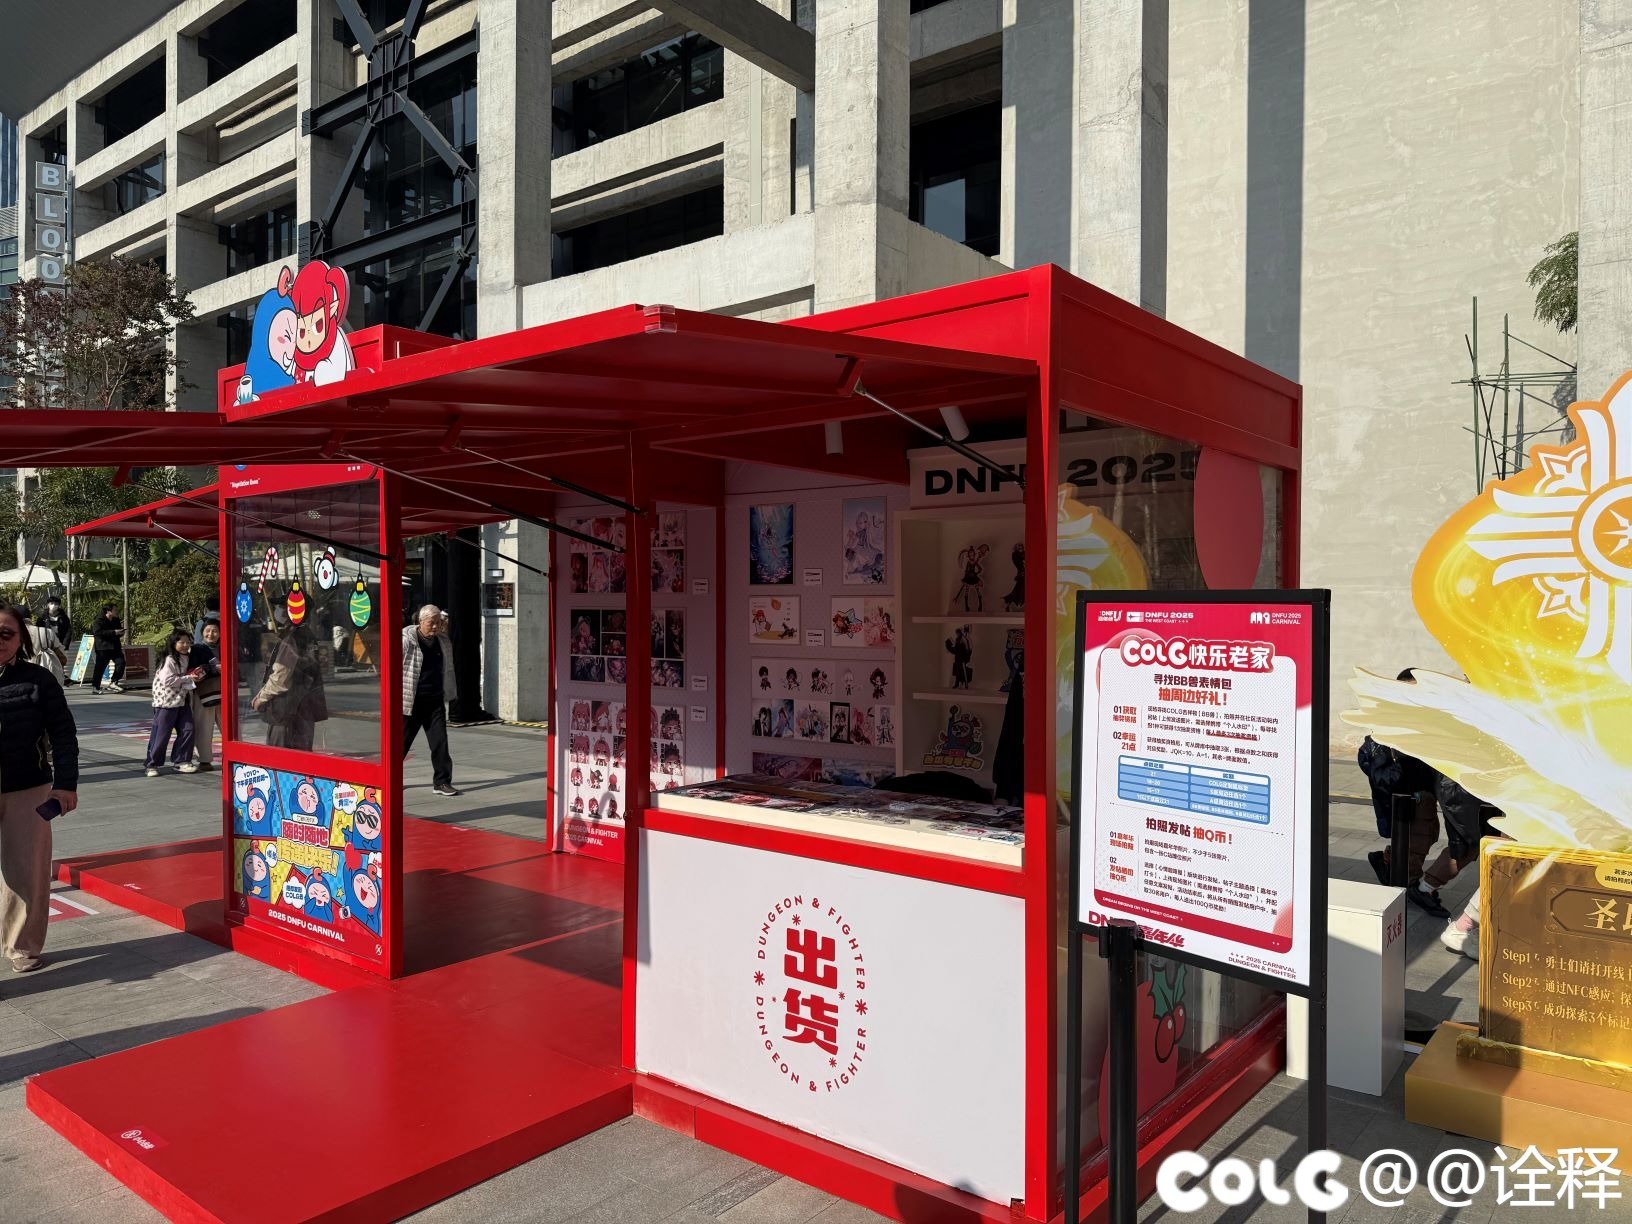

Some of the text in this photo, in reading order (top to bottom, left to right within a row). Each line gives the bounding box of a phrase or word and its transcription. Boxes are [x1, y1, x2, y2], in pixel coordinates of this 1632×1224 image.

[924, 463, 1027, 496] DNF
[1145, 611, 1169, 619] DNFU
[1153, 673, 1232, 691] 寻找BB兽表情包
[595, 829, 618, 839] FIGHTER
[1145, 817, 1191, 837] 拍照发帖
[1109, 856, 1117, 864] 02
[268, 909, 345, 943] 2025 DNFU CARNIVAL
[757, 895, 866, 990] DUNGEON & FIGHTER
[1228, 956, 1260, 969] DUNGEON
[1267, 967, 1297, 980] FIGHTER
[1246, 955, 1297, 974] 2025 CARNIVAL
[1502, 948, 1632, 982] Step1 勇士们请打开线
[1502, 972, 1532, 989] Step2
[782, 927, 839, 1056] 出货
[1502, 995, 1532, 1012] Step3
[756, 996, 867, 1092] DUNGEON & FIGHTER
